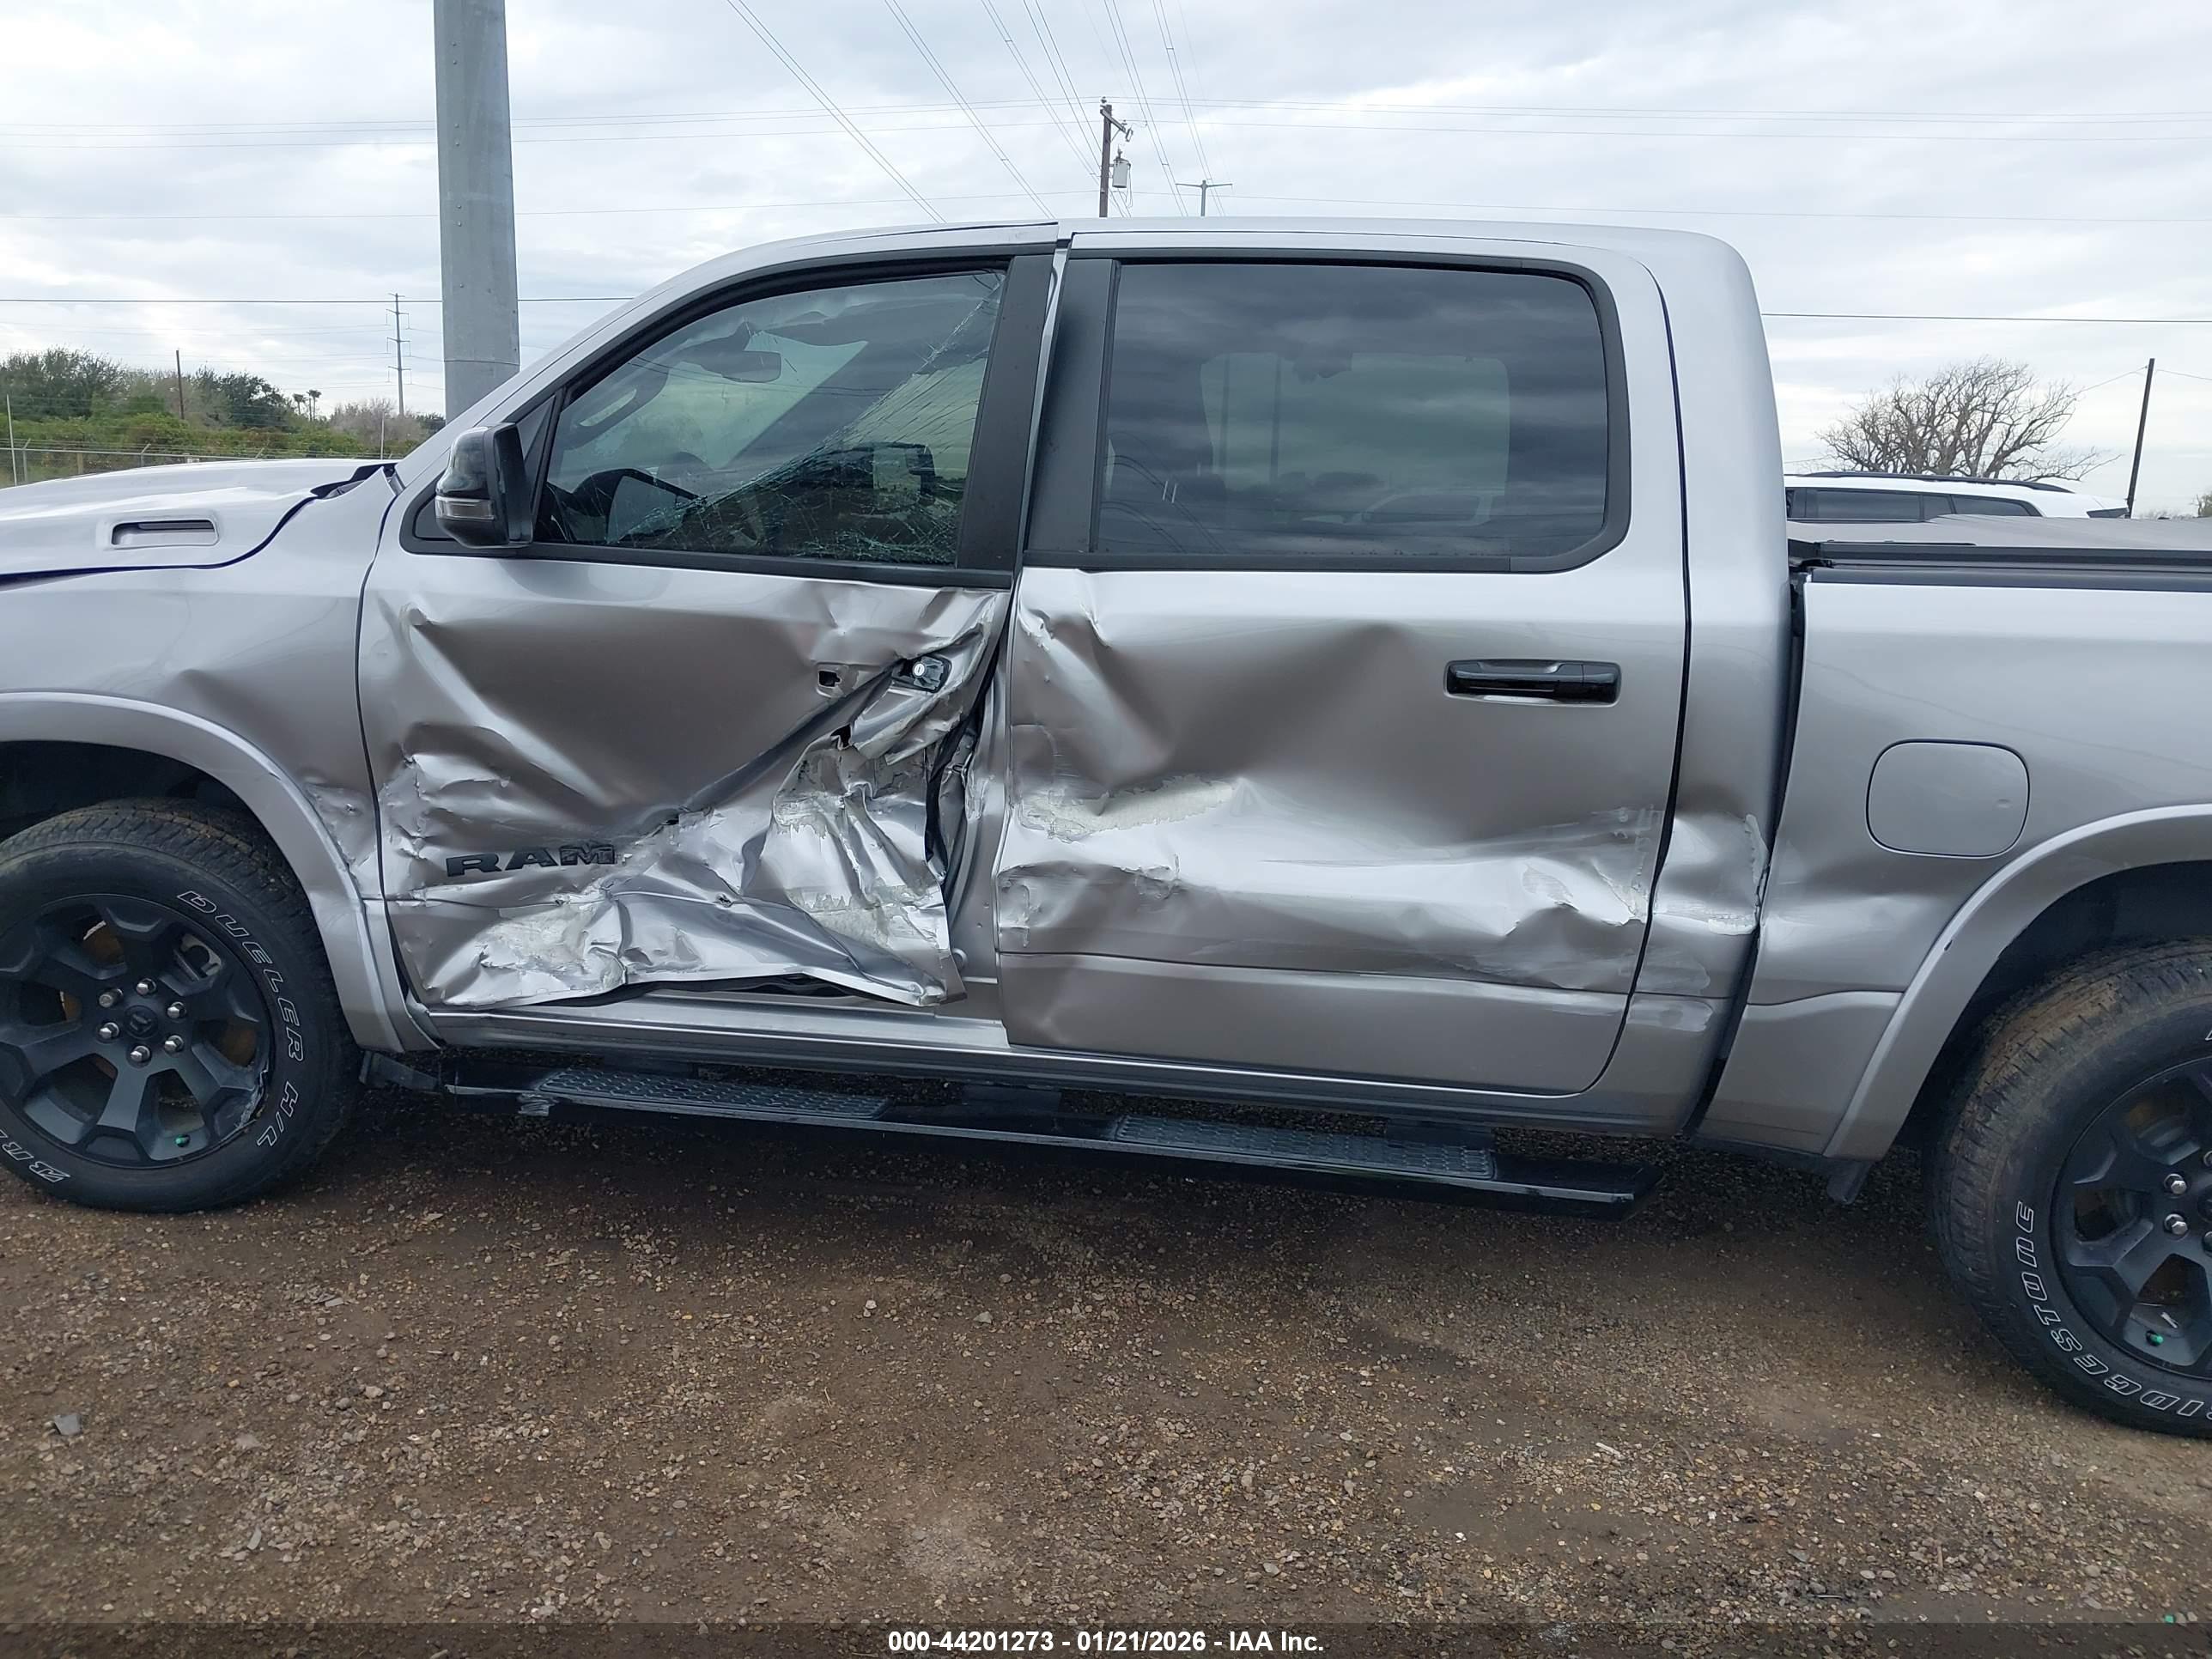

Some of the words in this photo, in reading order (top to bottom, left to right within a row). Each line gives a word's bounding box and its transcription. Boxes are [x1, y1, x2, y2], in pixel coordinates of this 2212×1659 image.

[446, 844, 616, 878] RAM
[177, 890, 305, 1062] DUELER
[2014, 1200, 2212, 1421] IDGESTONE
